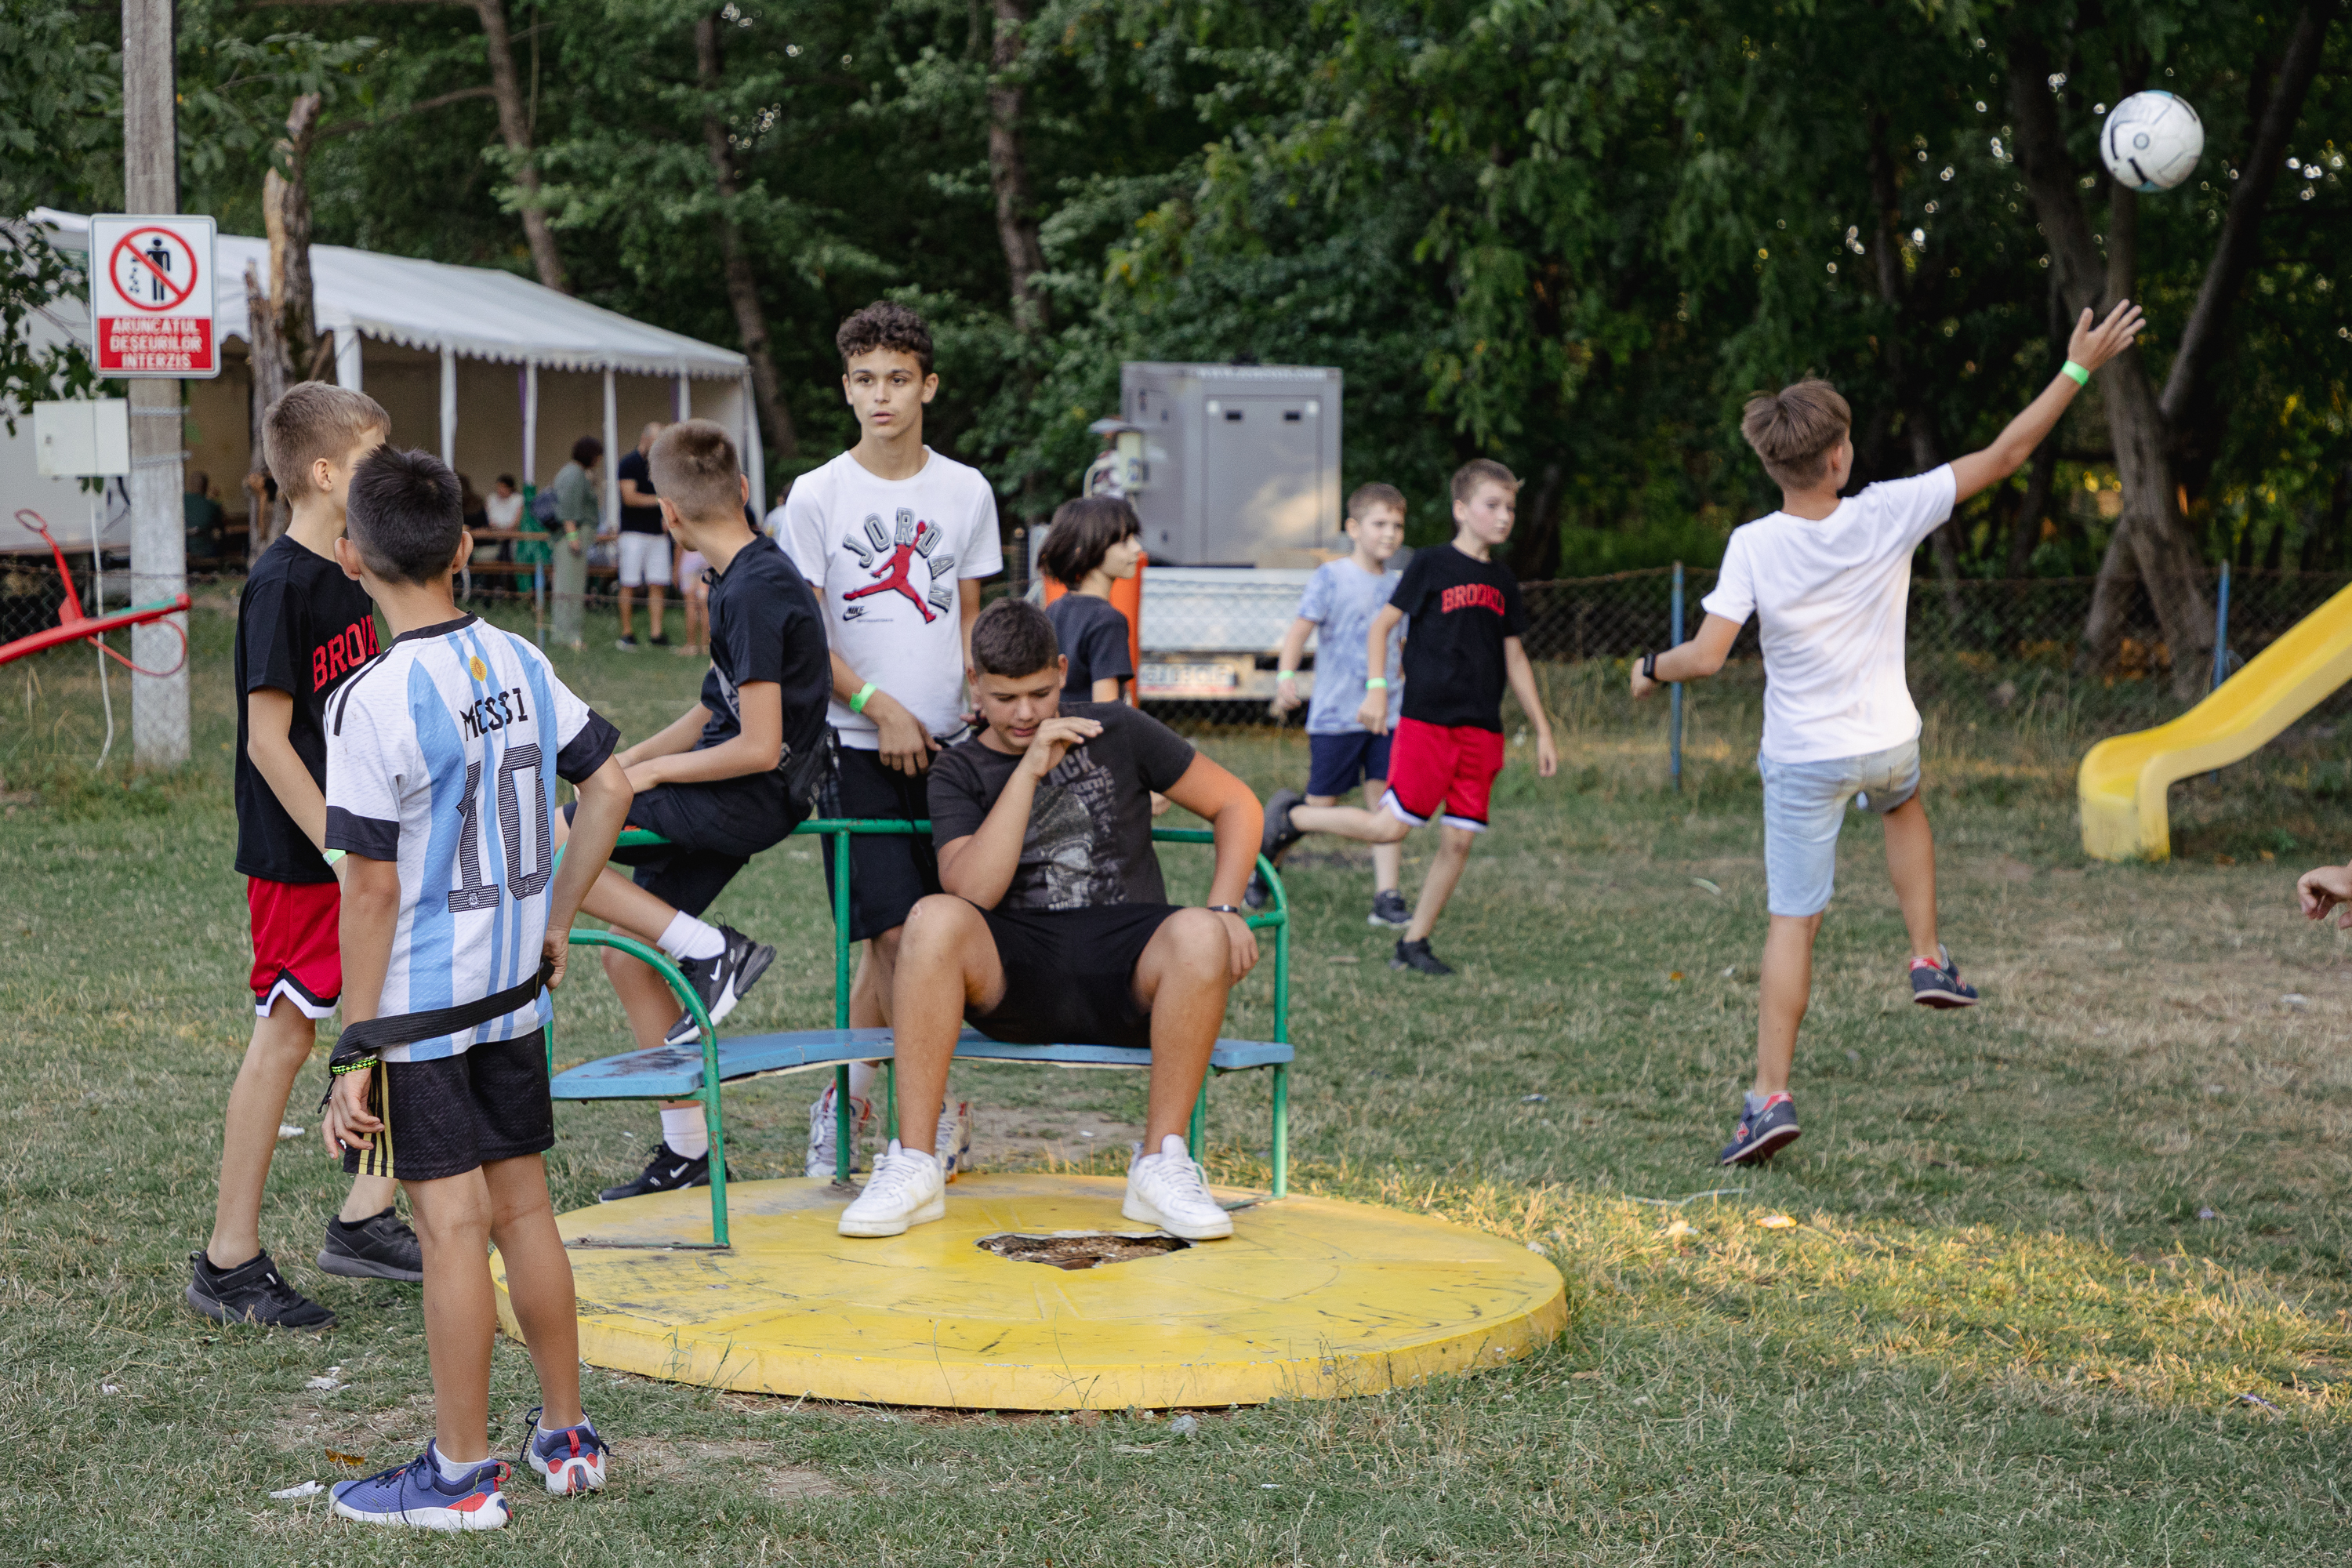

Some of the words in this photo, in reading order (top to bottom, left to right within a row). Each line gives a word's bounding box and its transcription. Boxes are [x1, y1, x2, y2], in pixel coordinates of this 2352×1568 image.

[111, 318, 200, 335] ARUNCATUL
[122, 353, 192, 370] INTERZIS
[843, 507, 955, 613] JORDAN
[846, 605, 865, 615] NIKE
[459, 687, 528, 742] MESSI
[448, 743, 552, 913] 10
